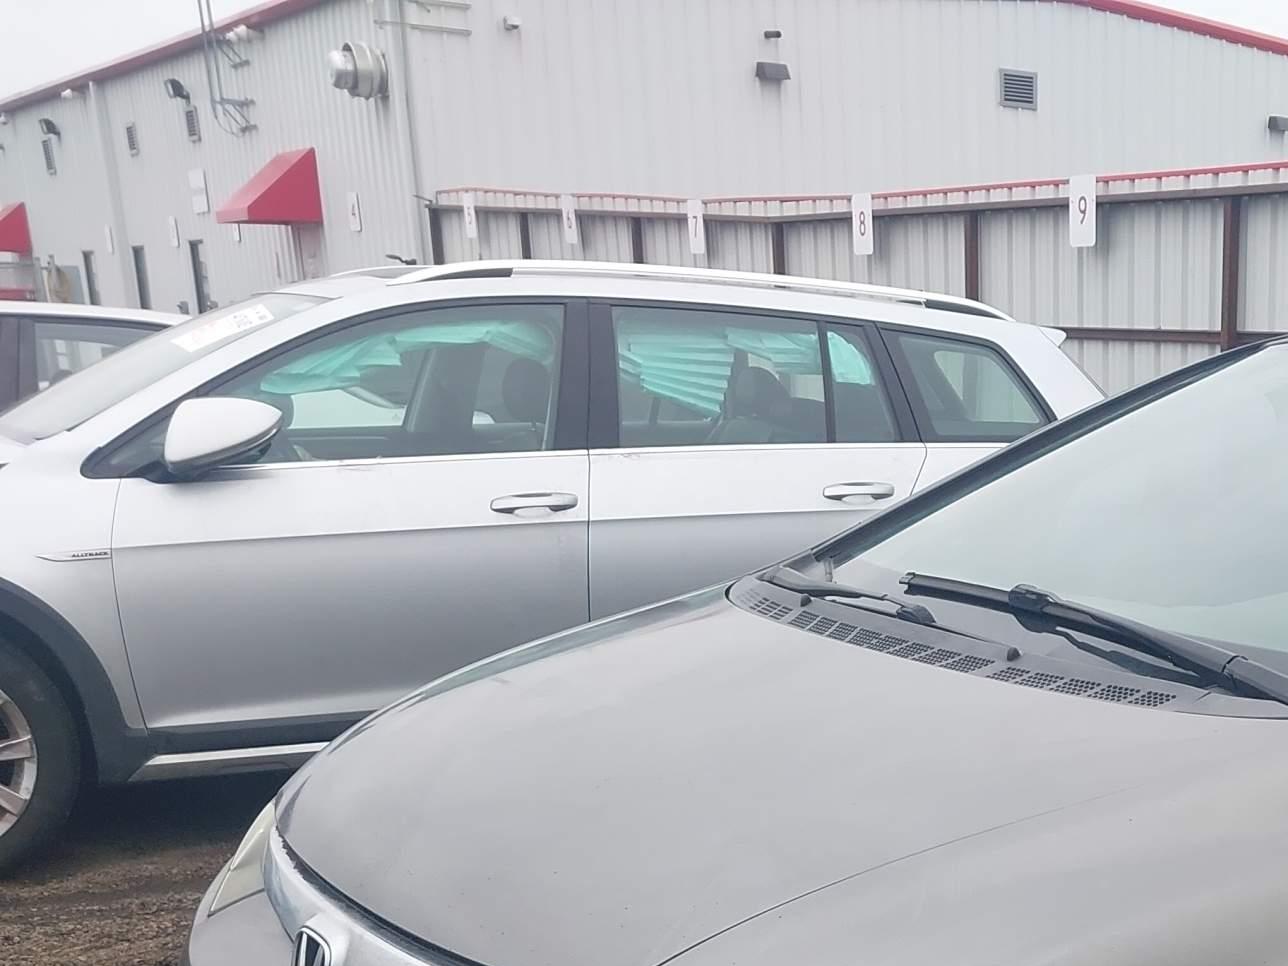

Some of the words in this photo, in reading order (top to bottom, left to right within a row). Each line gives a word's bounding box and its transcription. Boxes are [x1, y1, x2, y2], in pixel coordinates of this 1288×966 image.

[858, 210, 867, 237] 8
[1077, 195, 1088, 225] 9
[692, 215, 698, 238] 7
